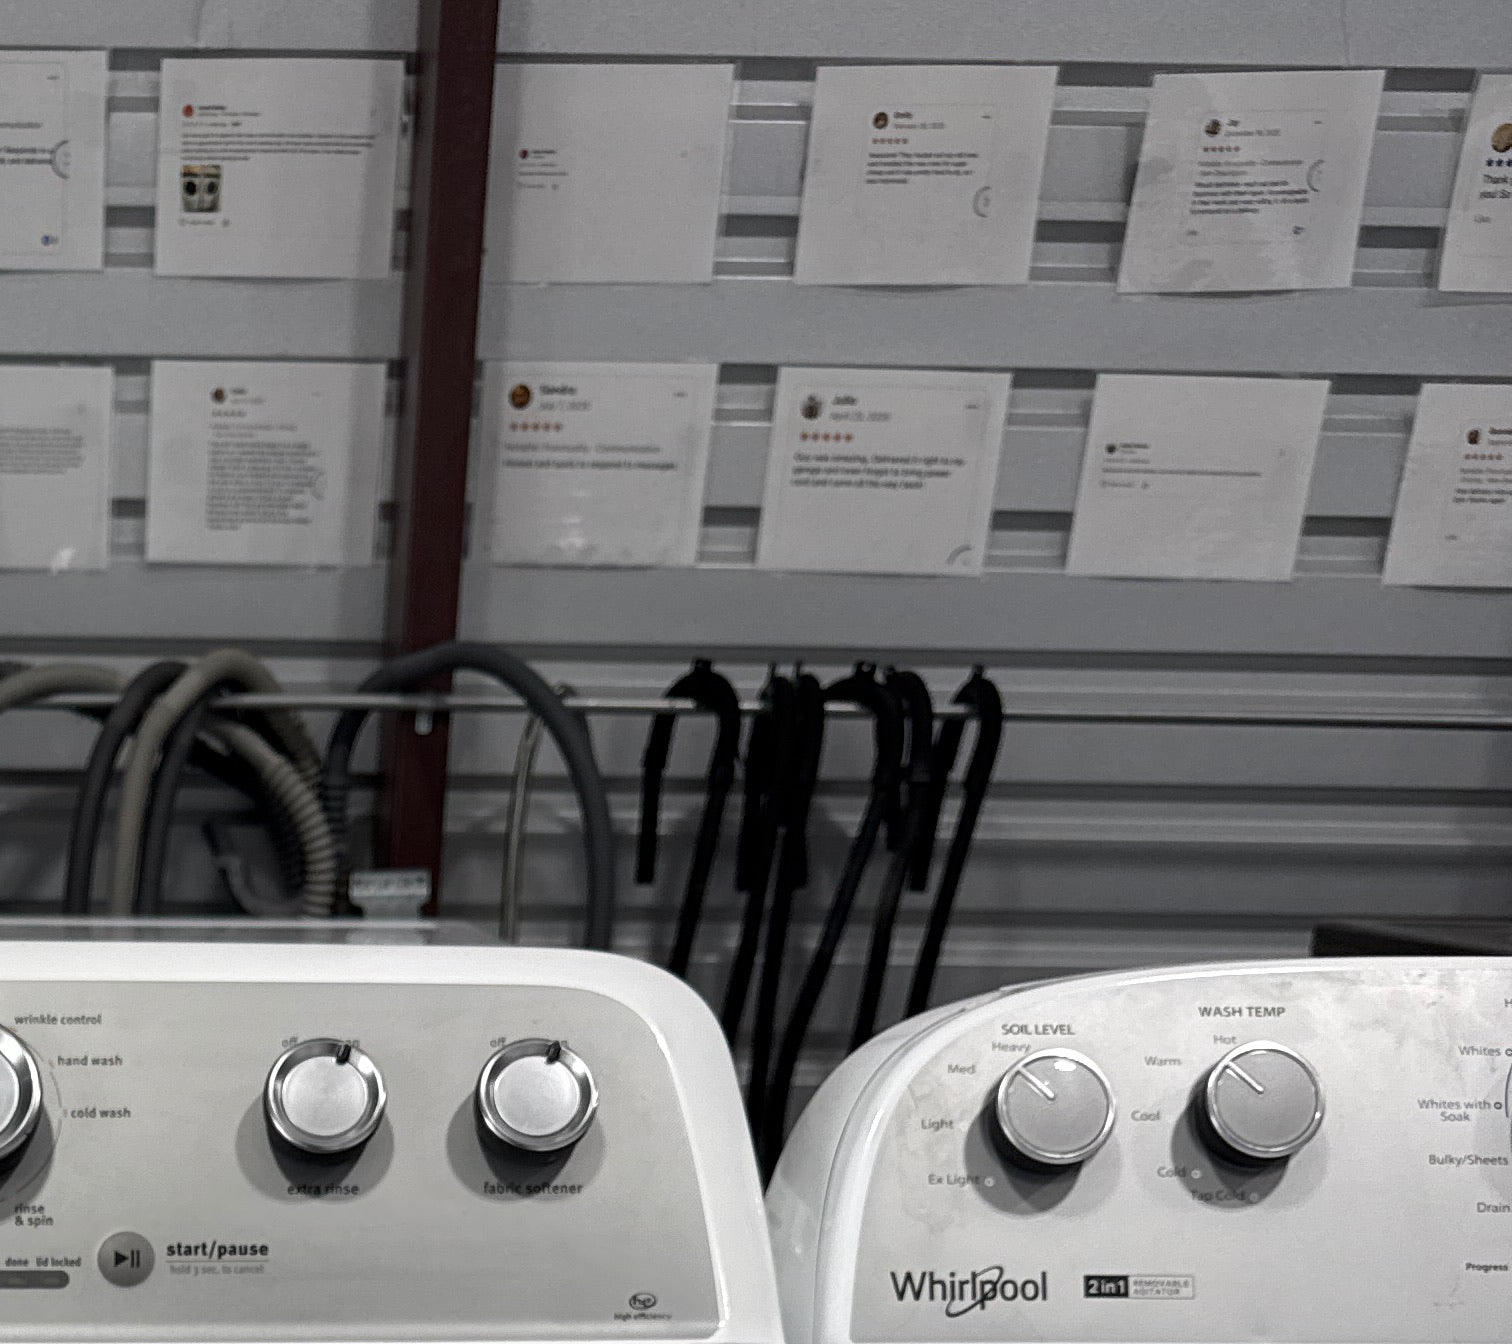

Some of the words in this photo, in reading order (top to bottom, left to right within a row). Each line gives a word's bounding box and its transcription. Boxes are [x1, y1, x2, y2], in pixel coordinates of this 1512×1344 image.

[1199, 1006, 1242, 1018] WASH
[1246, 1006, 1286, 1018] TEMP
[14, 1014, 57, 1025] wrinkle
[60, 1014, 102, 1025] control
[1002, 1024, 1032, 1036] SOIL
[1035, 1024, 1075, 1036] LEVEL
[1213, 1035, 1236, 1046] Hot
[992, 1042, 1032, 1054] Heavy
[1458, 1046, 1501, 1057] Whites
[58, 1055, 88, 1066] hand
[91, 1055, 123, 1066] wash
[1145, 1056, 1181, 1067] Warm
[947, 1064, 975, 1074] Med
[1417, 1099, 1460, 1110] Whites
[1463, 1099, 1492, 1110] with
[70, 1108, 96, 1118] cold
[99, 1108, 131, 1118] wash
[1131, 1111, 1161, 1122] Cool
[1440, 1111, 1470, 1122] Soak
[921, 1118, 954, 1131] Light
[1429, 1154, 1509, 1168] Bulky/Sheets
[1157, 1167, 1186, 1178] Cold
[947, 1174, 980, 1187] Light
[287, 1184, 321, 1195] extra
[325, 1183, 359, 1195] rinse
[483, 1182, 522, 1194] fabric
[526, 1182, 583, 1194] softener
[1190, 1190, 1215, 1204] Tap
[1216, 1190, 1246, 1202] Cold
[14, 1204, 45, 1214] rinse
[1477, 1202, 1511, 1213] Drain
[15, 1215, 24, 1226] &
[28, 1215, 54, 1228] spin
[166, 1240, 269, 1260] start/pause
[5, 1257, 29, 1267] done
[1465, 1262, 1509, 1273] Progress
[890, 1266, 1047, 1316] Whirlpool
